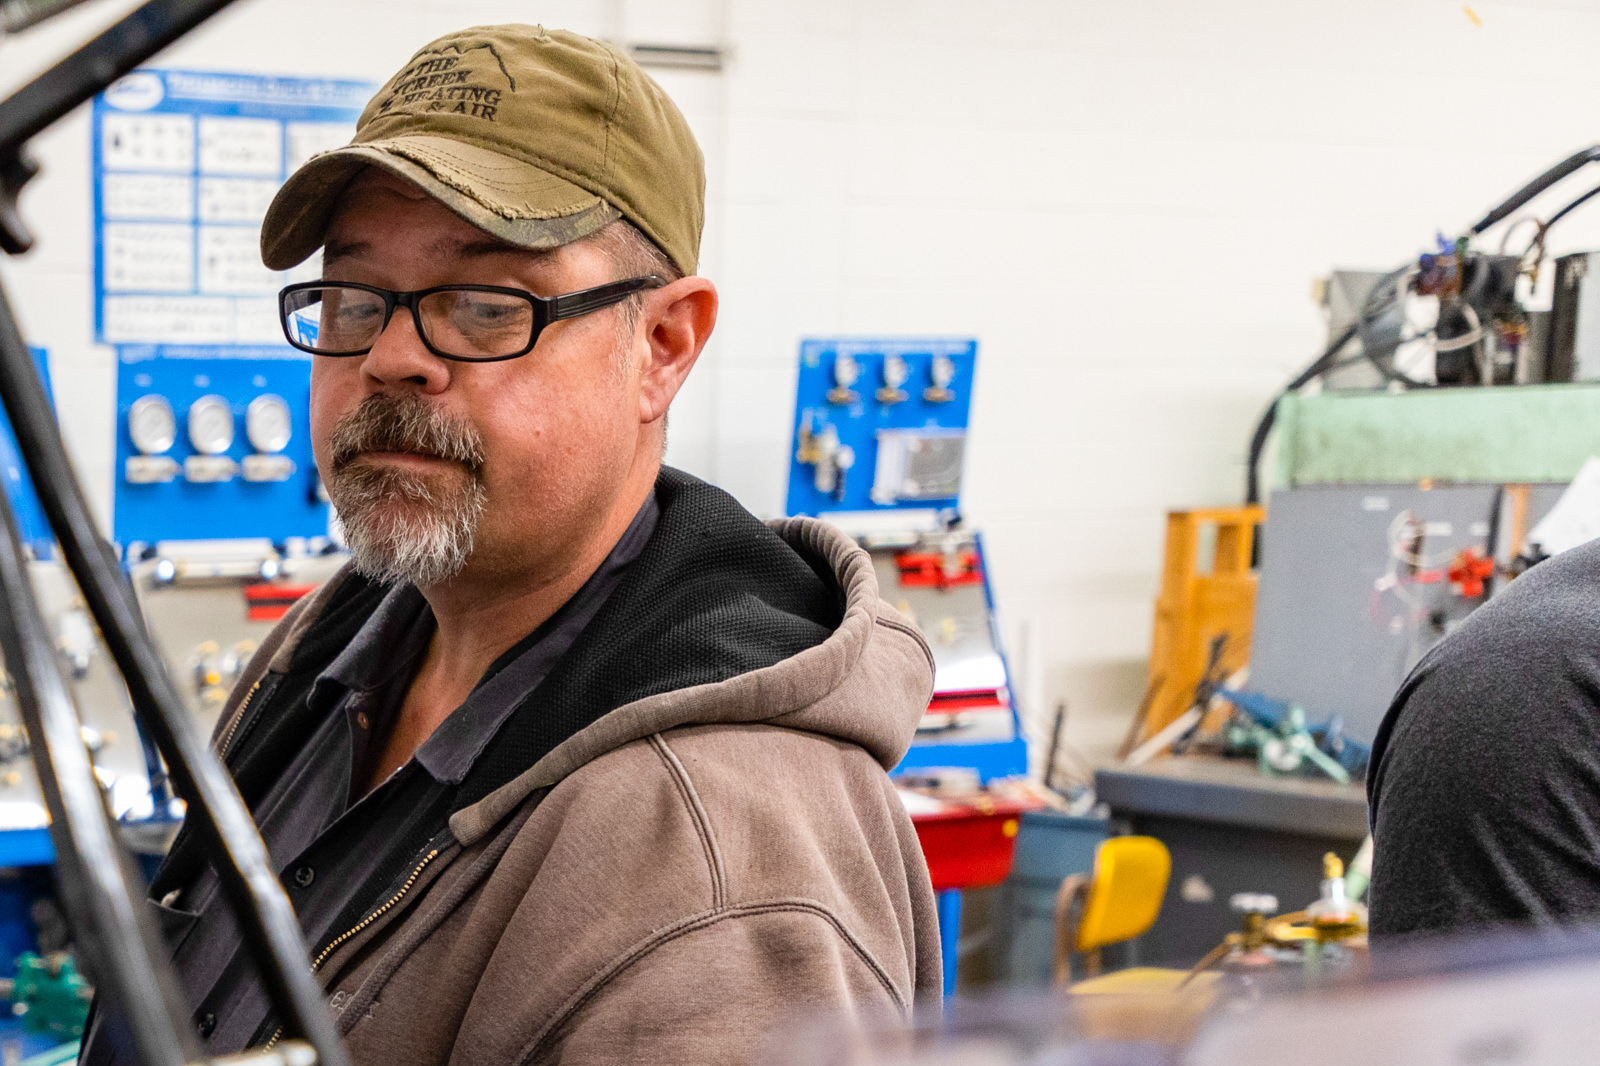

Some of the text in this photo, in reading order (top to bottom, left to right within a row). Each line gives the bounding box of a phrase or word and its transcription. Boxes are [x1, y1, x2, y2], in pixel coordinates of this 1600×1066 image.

[414, 57, 459, 76] THE
[401, 70, 473, 95] CREEK
[403, 86, 502, 106] HEATING
[425, 100, 498, 122] & AIR
